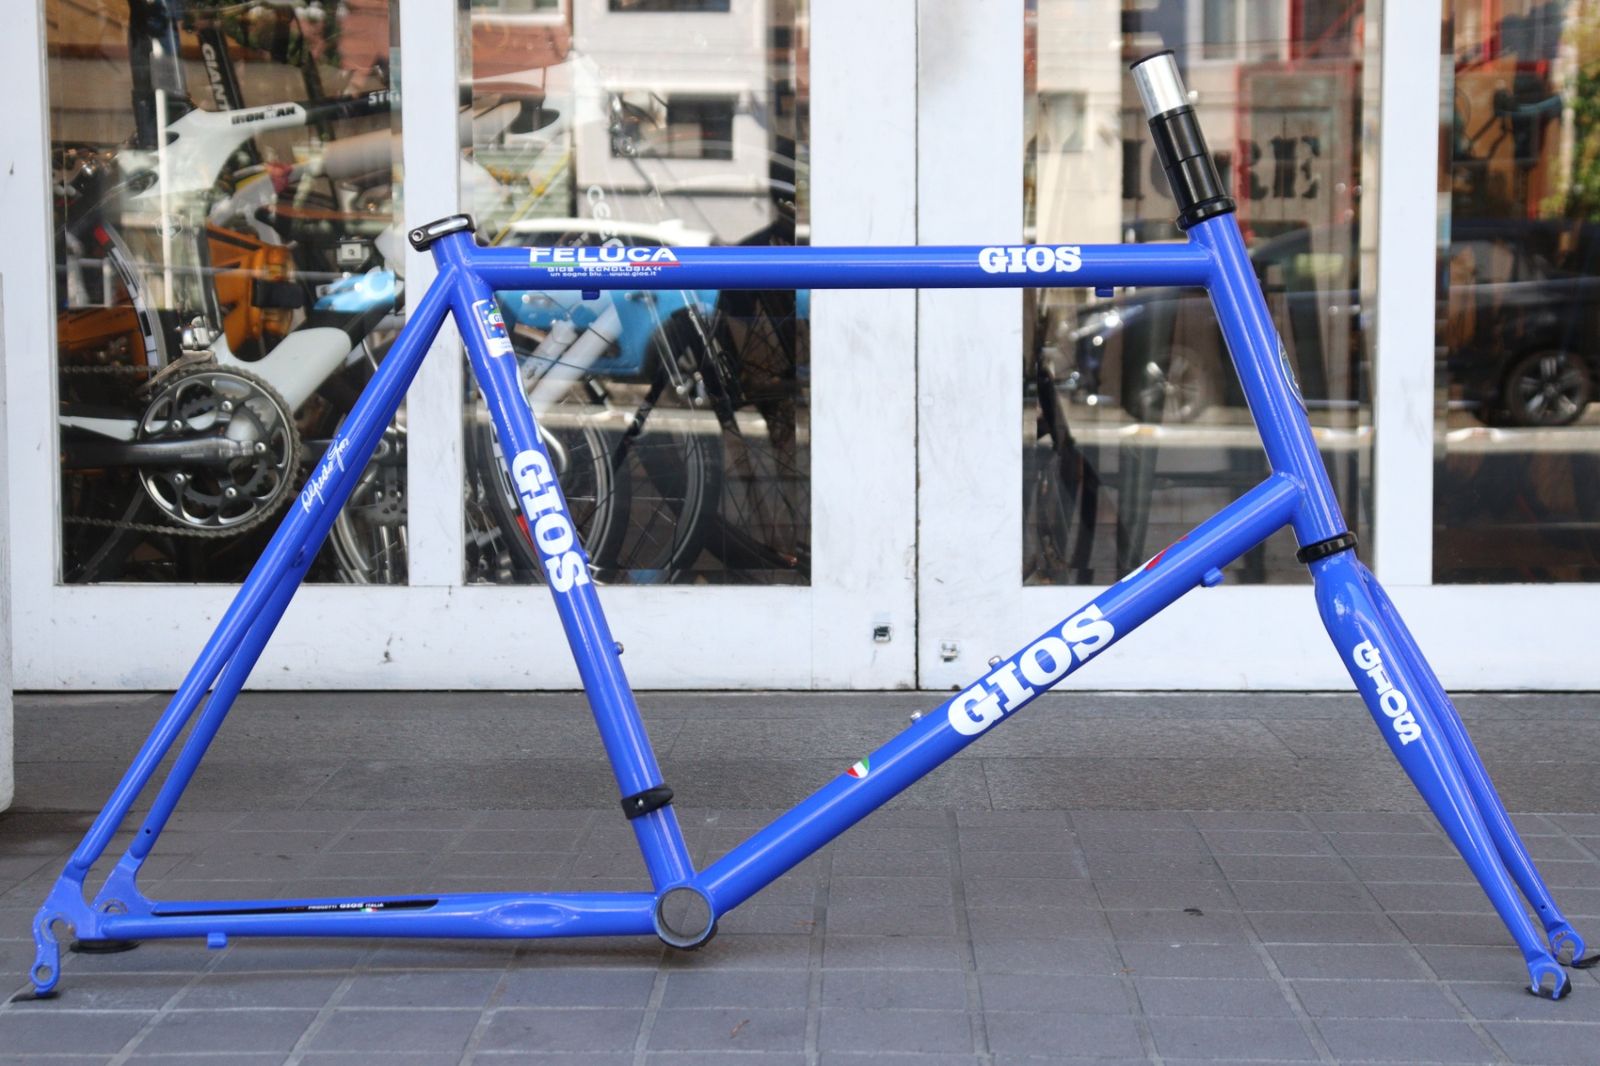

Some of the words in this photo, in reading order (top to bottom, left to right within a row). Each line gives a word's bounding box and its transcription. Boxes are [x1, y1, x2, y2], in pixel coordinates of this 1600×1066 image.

[202, 42, 232, 112] GIANT
[529, 247, 678, 262] FELUCA
[979, 246, 1082, 274] GIOS
[512, 449, 590, 593] GIOS
[947, 603, 1115, 736] GIOS
[1352, 639, 1422, 746] GIOS
